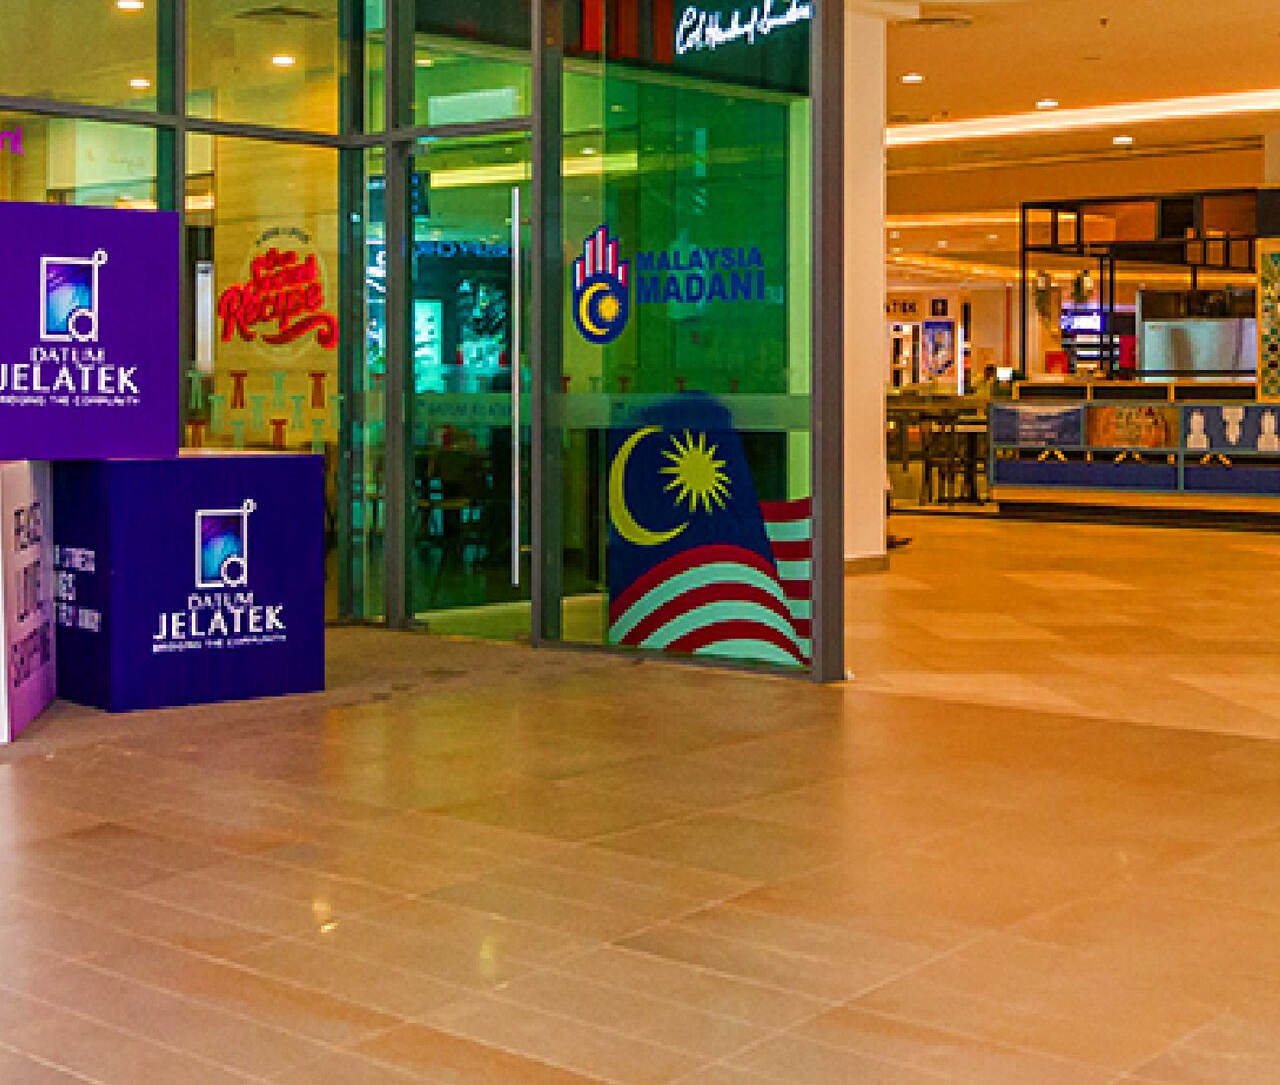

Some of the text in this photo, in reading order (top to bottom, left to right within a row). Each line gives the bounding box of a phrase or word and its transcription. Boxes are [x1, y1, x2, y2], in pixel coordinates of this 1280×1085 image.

[637, 246, 763, 274] MALAYSIA
[637, 270, 765, 305] MADANI
[217, 282, 339, 351] Recipe
[30, 346, 105, 365] DATUM
[50, 396, 70, 406] THE
[73, 395, 140, 407] COMMUNITY
[186, 592, 255, 611] DATUM
[152, 604, 287, 642] JELATEK
[205, 638, 223, 648] THE
